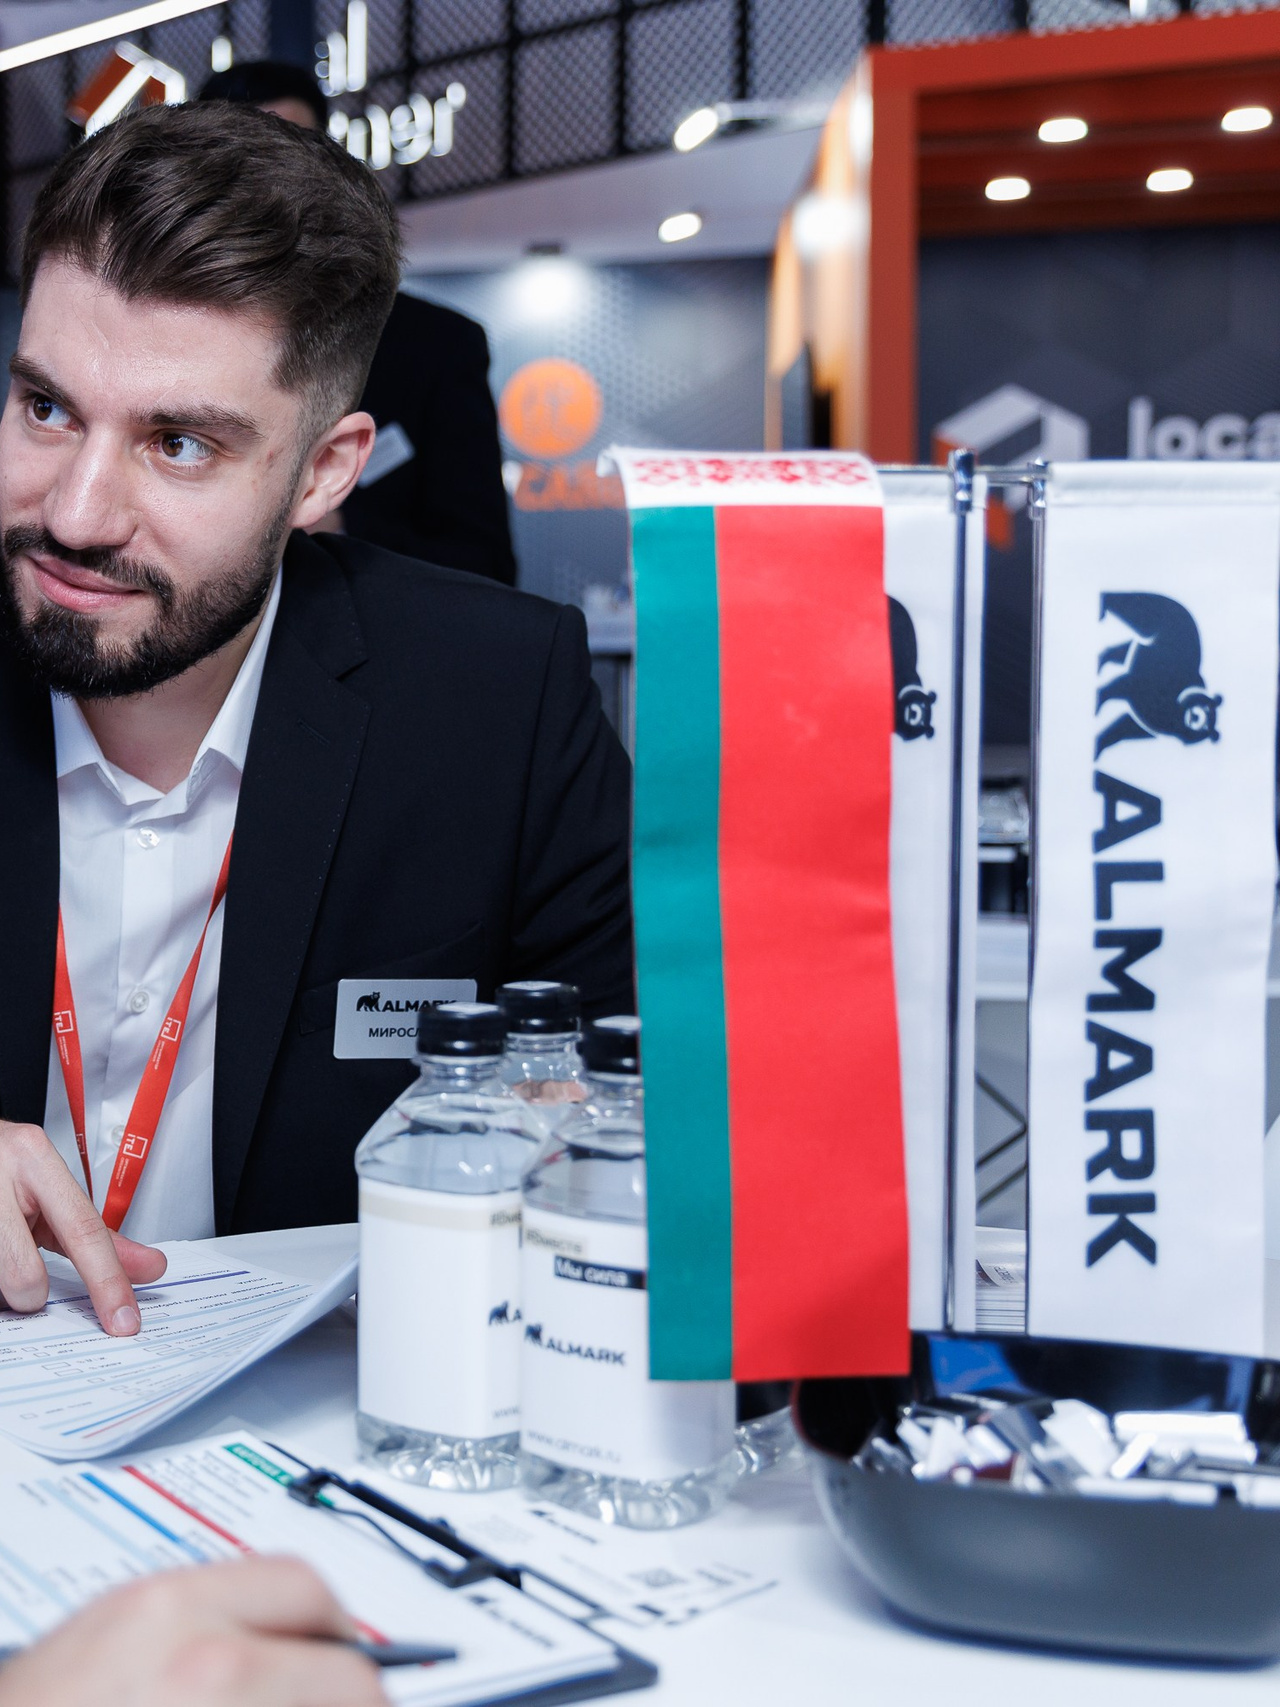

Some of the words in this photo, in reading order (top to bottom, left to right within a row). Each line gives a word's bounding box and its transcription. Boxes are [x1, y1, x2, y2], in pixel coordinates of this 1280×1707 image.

[382, 1000, 456, 1012] ALMA
[1084, 769, 1165, 1268] ALMARK
[545, 1338, 626, 1367] ALMARK
